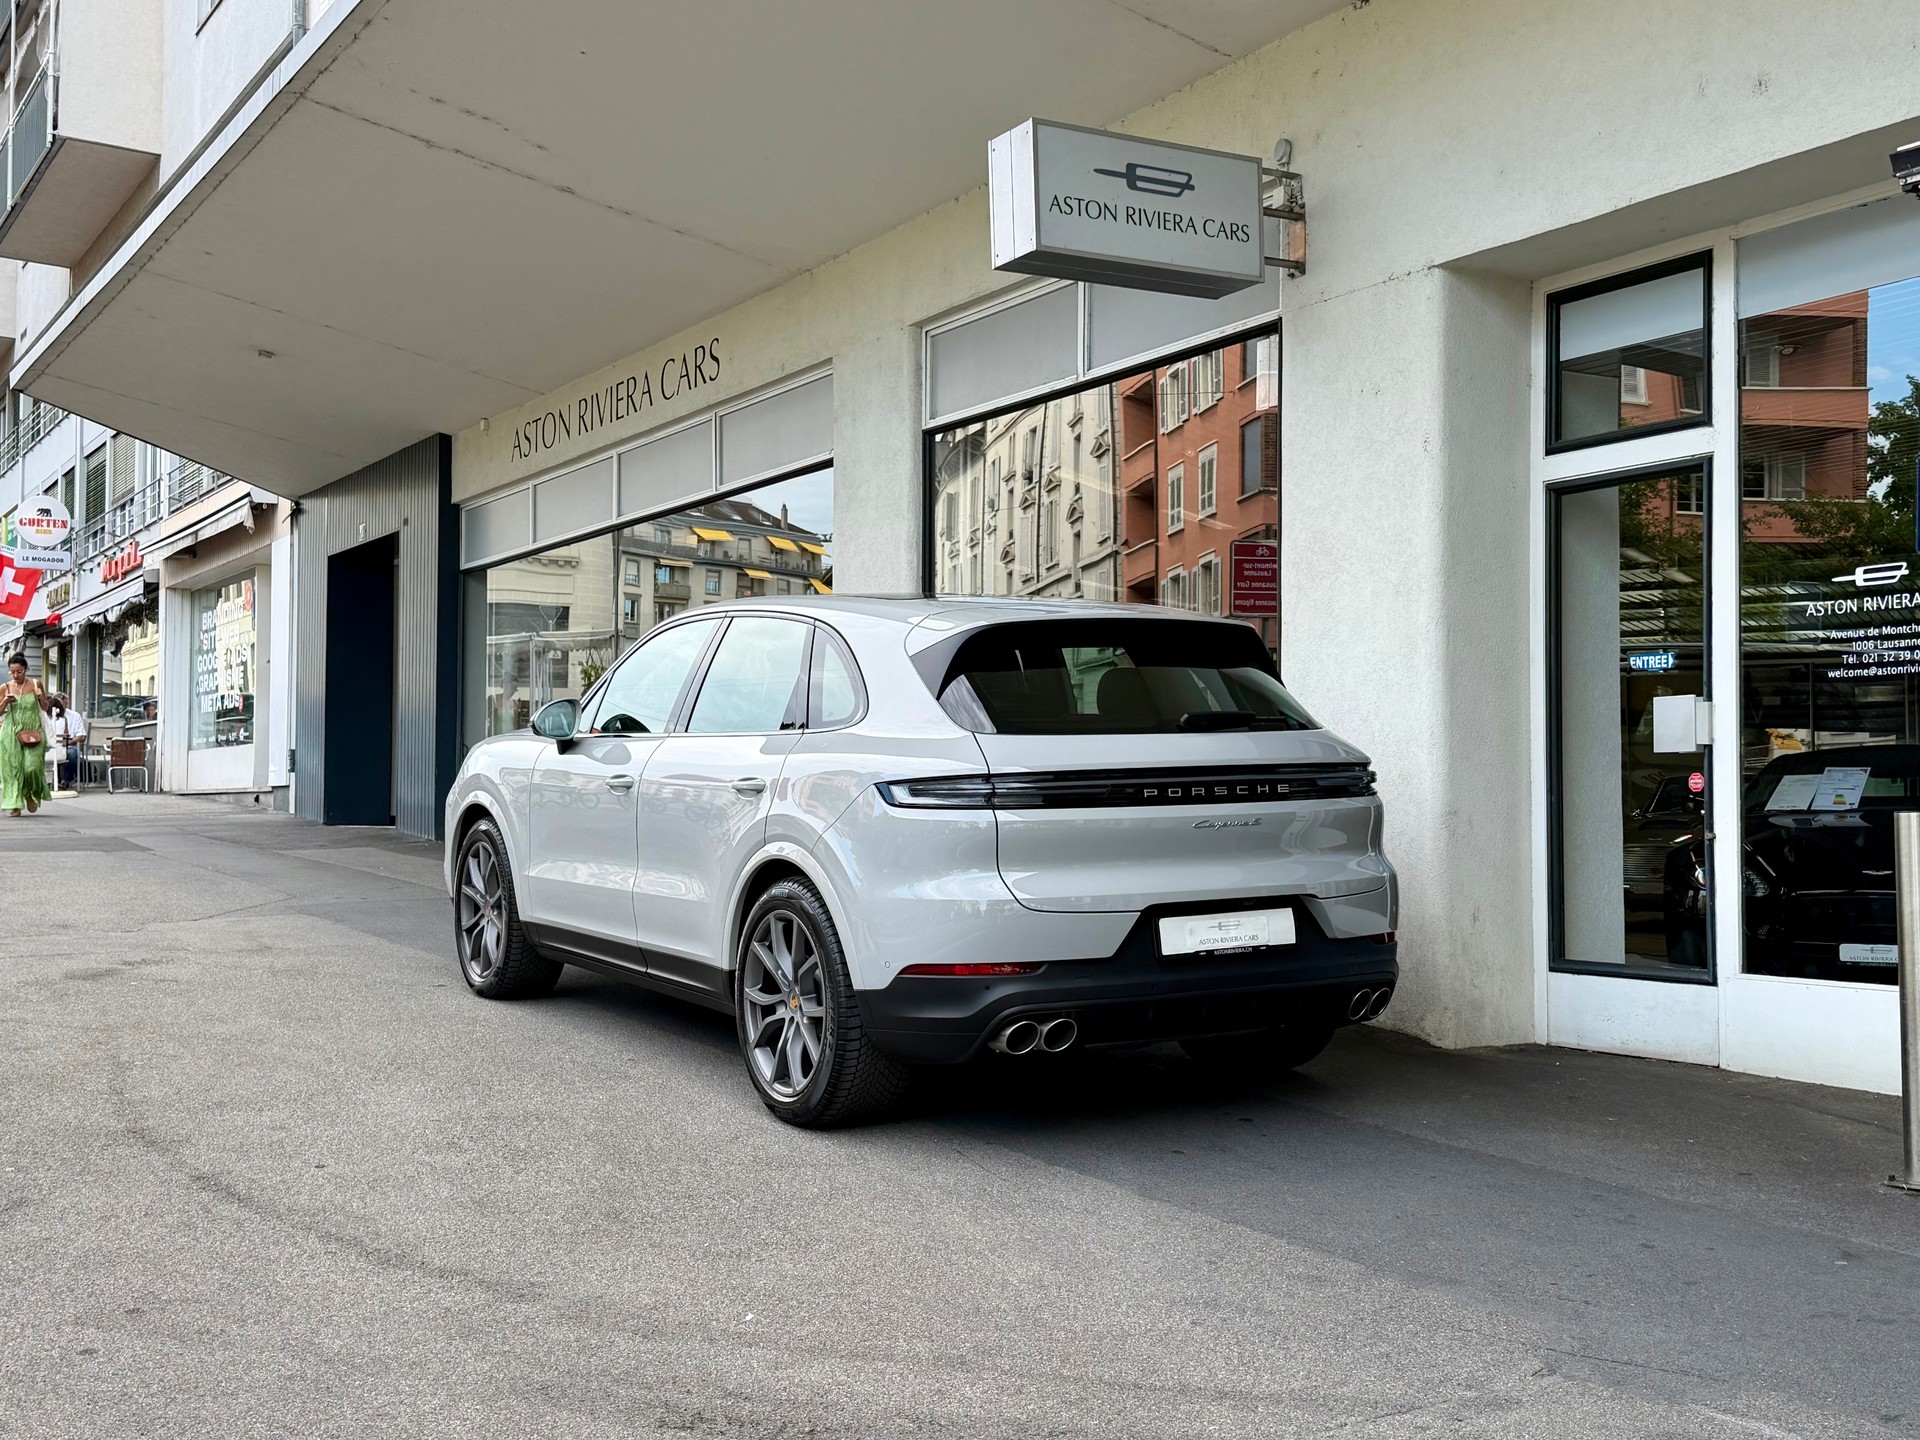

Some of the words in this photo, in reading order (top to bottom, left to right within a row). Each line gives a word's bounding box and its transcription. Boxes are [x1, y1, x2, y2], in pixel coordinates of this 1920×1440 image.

[1049, 194, 1118, 223] ASTON
[1126, 206, 1198, 235] RIVIERA
[1202, 218, 1250, 243] CARS
[511, 404, 571, 463] ASTON
[578, 370, 653, 436] RIVIERA
[660, 337, 720, 400] CARS
[18, 517, 68, 529] GURTEN
[1806, 598, 1857, 617] ASTON
[1863, 592, 1920, 612] RIVIERA
[202, 602, 244, 631] BRANDING
[202, 631, 220, 650] SIT
[223, 624, 240, 645] WEB
[1830, 630, 1865, 640] Avenue
[1867, 627, 1879, 636] de
[1852, 640, 1874, 650] 1006
[198, 647, 228, 673] GOOGE
[1630, 655, 1668, 668] ENTREE
[1842, 654, 1859, 664] Tél.
[1862, 653, 1878, 663] 021
[1883, 652, 1894, 662] 32
[1899, 650, 1910, 661] 39
[1828, 664, 1920, 678] welcome@astonrivi
[200, 694, 222, 714] META
[223, 690, 240, 710] ADS
[1144, 784, 1290, 798] PORSCHE
[1192, 820, 1249, 830] Cayenne
[1220, 936, 1242, 944] RIVIERA
